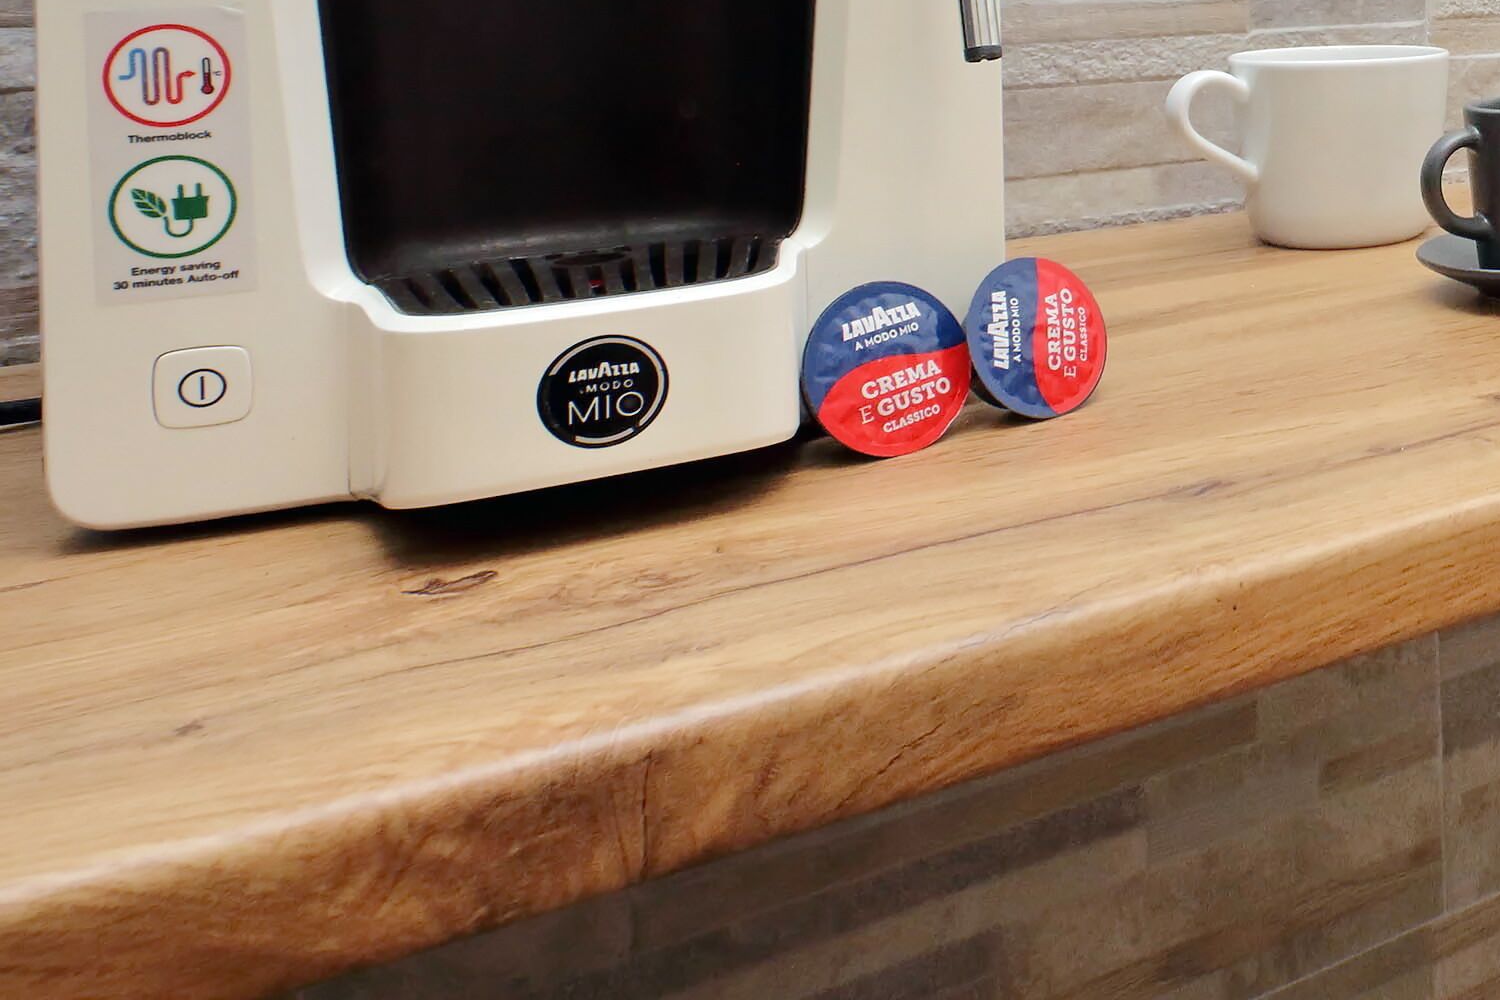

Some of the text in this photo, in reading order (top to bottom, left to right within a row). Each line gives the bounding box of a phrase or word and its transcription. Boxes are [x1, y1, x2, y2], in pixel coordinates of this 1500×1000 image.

[127, 130, 212, 143] Thermoblock
[113, 270, 239, 290] 30 minutes Auto-off
[131, 261, 221, 276] Energy saving
[841, 302, 921, 342] LAVAZZA
[855, 322, 919, 351] A MODO MIO
[987, 290, 1010, 370] LAVAZZA
[1010, 297, 1022, 363] A MODO MIO
[1045, 293, 1062, 371] CREMA
[1059, 288, 1077, 378] E GUSTO
[1077, 306, 1088, 362] CLASSICO
[568, 362, 640, 383] LAVAZZA
[585, 379, 634, 393] MODO
[861, 359, 942, 400] CREMA
[568, 391, 644, 425] MIO
[858, 377, 952, 425] E GUSTO
[882, 404, 941, 433] CLASSICO
